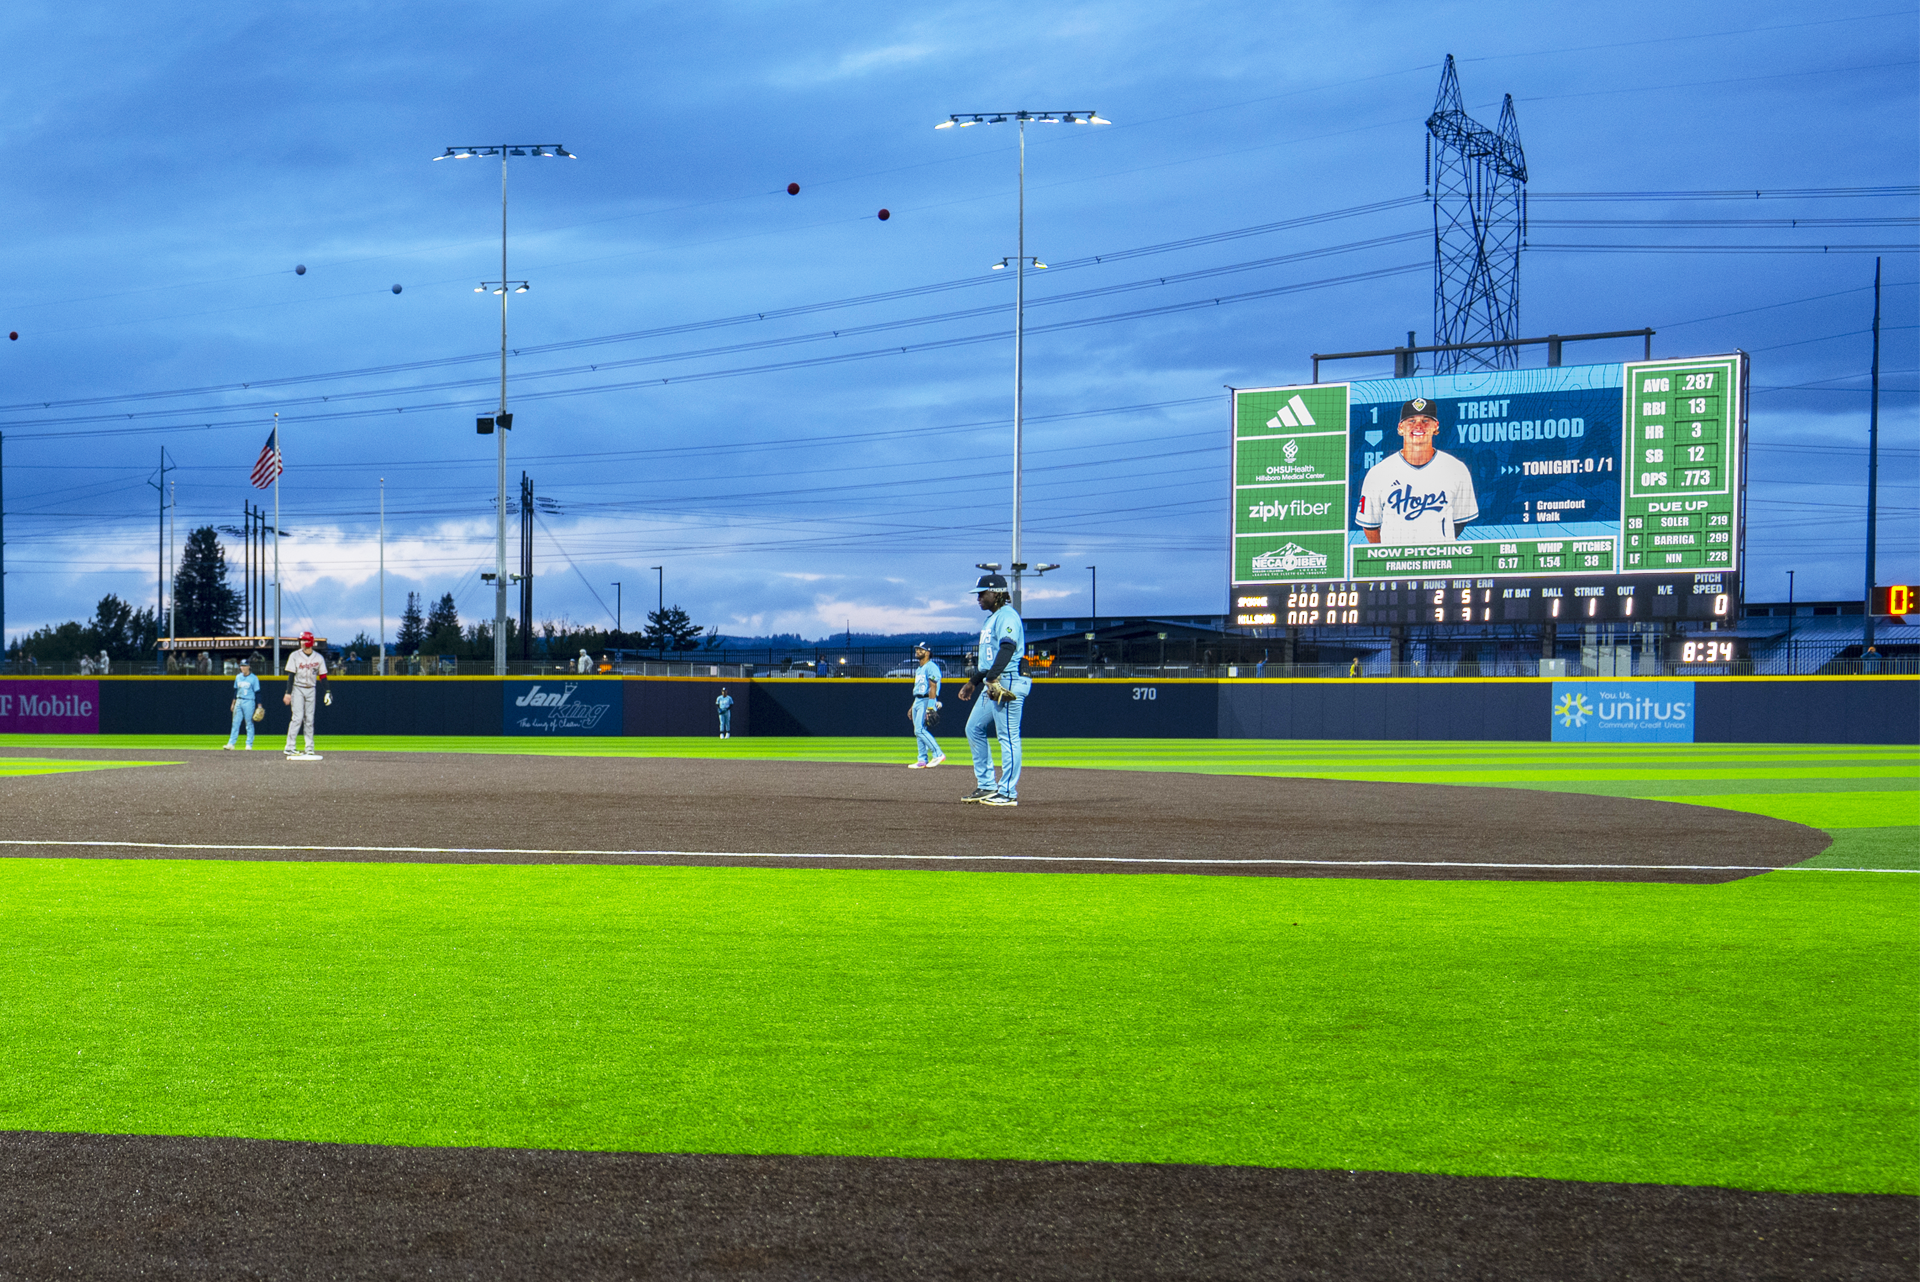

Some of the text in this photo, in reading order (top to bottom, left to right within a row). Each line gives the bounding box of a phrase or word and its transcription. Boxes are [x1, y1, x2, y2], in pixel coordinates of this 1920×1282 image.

[1643, 373, 1714, 393] AVG .287
[1458, 400, 1510, 419] TRENT
[1643, 398, 1706, 416] RBI 13
[1370, 407, 1378, 424] 1
[1457, 418, 1584, 443] YOUNGBLOOD
[1645, 422, 1702, 439] HR 3
[1645, 446, 1705, 463] SB 12
[1641, 470, 1710, 486] OPS .773
[1387, 484, 1448, 520] Hops
[1524, 500, 1585, 511] 1 Groundout
[1649, 501, 1708, 512] DUE UP
[1249, 500, 1332, 522] ziply fiber
[1523, 512, 1560, 522] 3 Walk
[1629, 515, 1728, 529] 3B SOLER .219
[1631, 533, 1728, 545] C BARRIGA .299
[1368, 546, 1473, 558] NOW PITCHING
[1500, 541, 1611, 554] ERA WHIP PITCHES
[1252, 557, 1327, 567] NECA IBEW
[1386, 560, 1452, 570] FRANCIS RIVERA
[1498, 555, 1599, 569] 6.17 1.54 38
[1629, 554, 1640, 564] LF
[1666, 553, 1682, 563] NIN
[1695, 573, 1721, 583] PITCH
[1291, 579, 1494, 592] 1 2 3 4 5 6 7 8 9 10 RUNS HITS ERR
[1542, 588, 1563, 597] BALL
[1574, 587, 1604, 597] STRIKE
[1617, 586, 1635, 596] OUT
[1658, 585, 1673, 595] H/E
[1693, 584, 1722, 594] SPEED
[1434, 590, 1444, 604] 2
[1461, 589, 1471, 604] 5
[1485, 589, 1490, 602] 1
[1503, 589, 1530, 598] AT BAT
[1552, 598, 1559, 617] 1
[1589, 598, 1596, 617] 1
[1625, 597, 1633, 616] 1
[1714, 594, 1728, 615] 0
[1485, 607, 1490, 621] 1
[986, 647, 993, 661] 9
[516, 685, 572, 706] Jani
[1132, 688, 1157, 700] 370
[1619, 691, 1632, 699] Us.
[18, 695, 92, 717] Mobile
[1599, 697, 1686, 720] unitus
